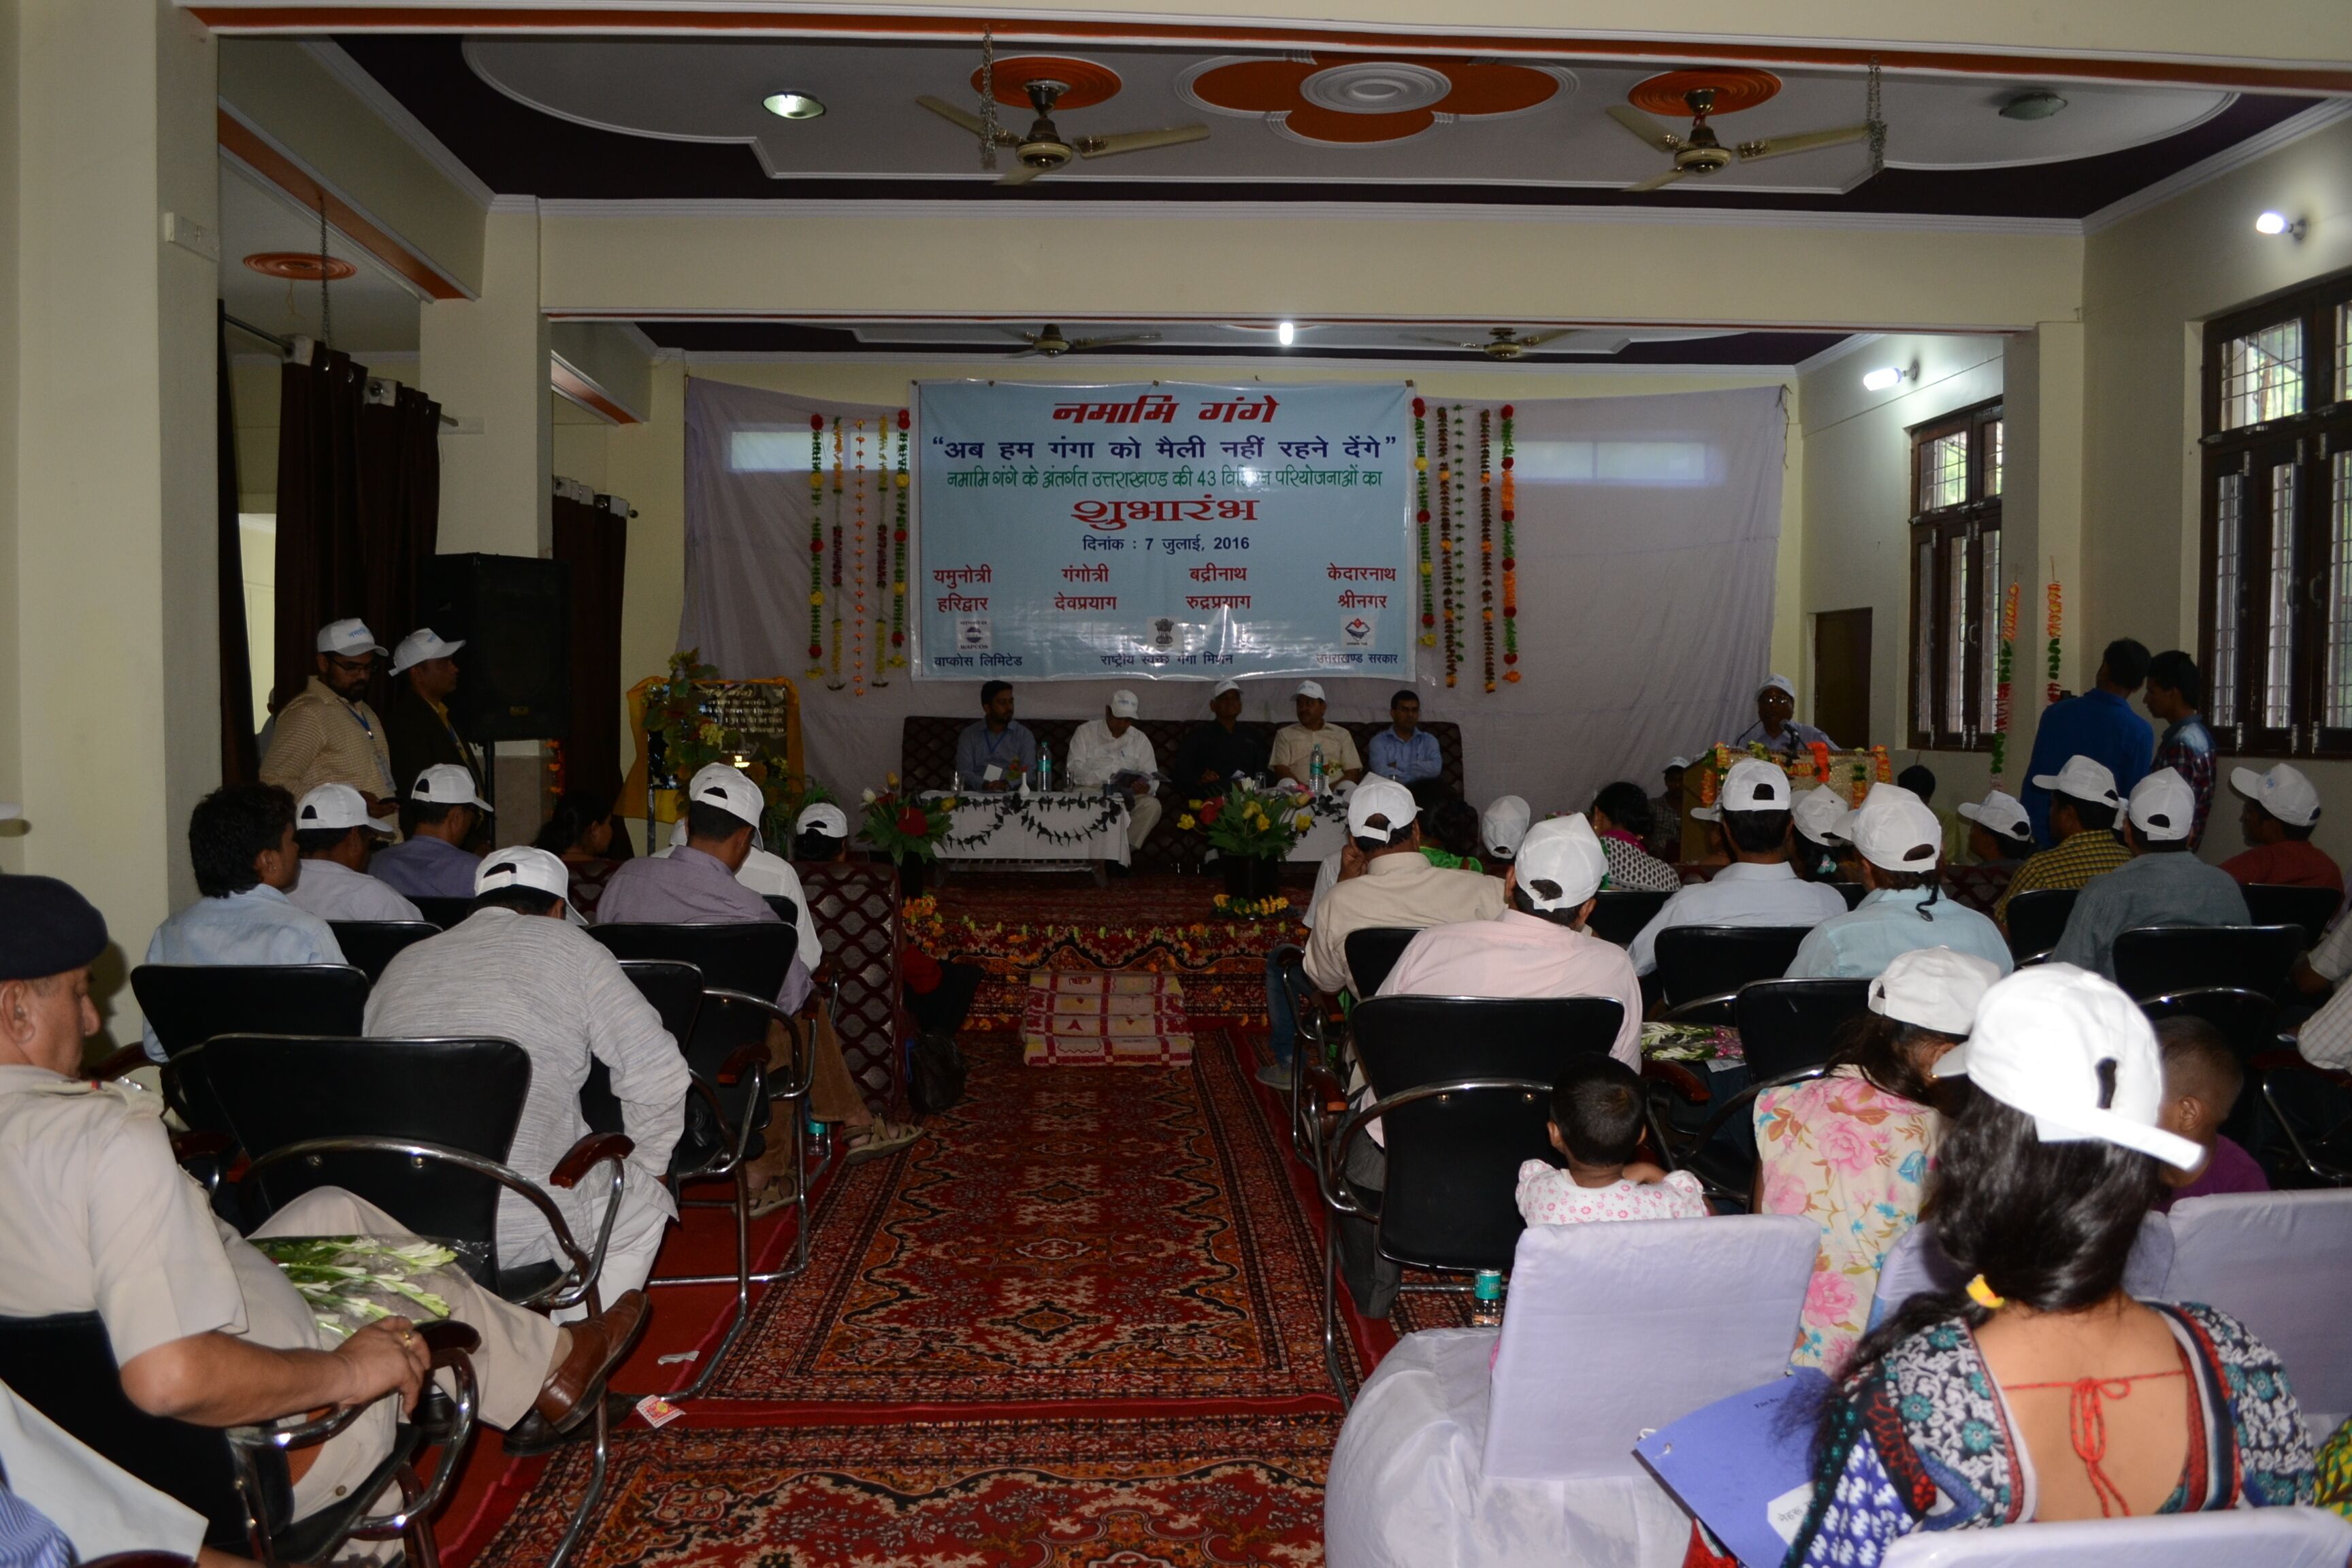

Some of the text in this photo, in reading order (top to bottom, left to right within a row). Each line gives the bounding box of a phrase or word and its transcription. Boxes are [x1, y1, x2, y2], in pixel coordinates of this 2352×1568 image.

[1053, 395, 1279, 423] नमामि गंगे
[933, 435, 1396, 460] “अब हम गंगा को मैली नहीं रहने देंगे”
[947, 466, 990, 487] नमामि
[993, 466, 1018, 487] गंगे
[1023, 466, 1039, 487] के
[1042, 465, 1088, 489] अंतर्गत
[1092, 471, 1168, 489] उत्तराखण्ड
[1173, 465, 1194, 487] की
[1197, 470, 1216, 487] 43
[1275, 464, 1358, 487] परियोजनाओं
[1362, 471, 1382, 486] का
[1071, 494, 1260, 531] शुभारंभ
[1083, 535, 1124, 551] दिनांक
[1145, 538, 1154, 550] 7
[1162, 534, 1205, 554] जुलाई,
[1214, 537, 1250, 549] 2016
[933, 564, 992, 589] यमुनोत्री
[1062, 564, 1109, 582] गंगोत्री
[1190, 563, 1247, 582] बद्रीनाथ
[1327, 563, 1396, 581] केदारनाथ
[937, 593, 988, 612] हरिद्वार
[1055, 592, 1117, 610] देवप्रयाग
[1186, 595, 1251, 610] रुद्रप्रयाग
[1338, 590, 1387, 608] श्रीनगर
[934, 653, 1022, 667] वाप्कोस लिमिटेड
[1100, 653, 1134, 668] राष्ट्रीय
[1177, 651, 1196, 664] गंगा
[1369, 654, 1398, 664] सरकार
